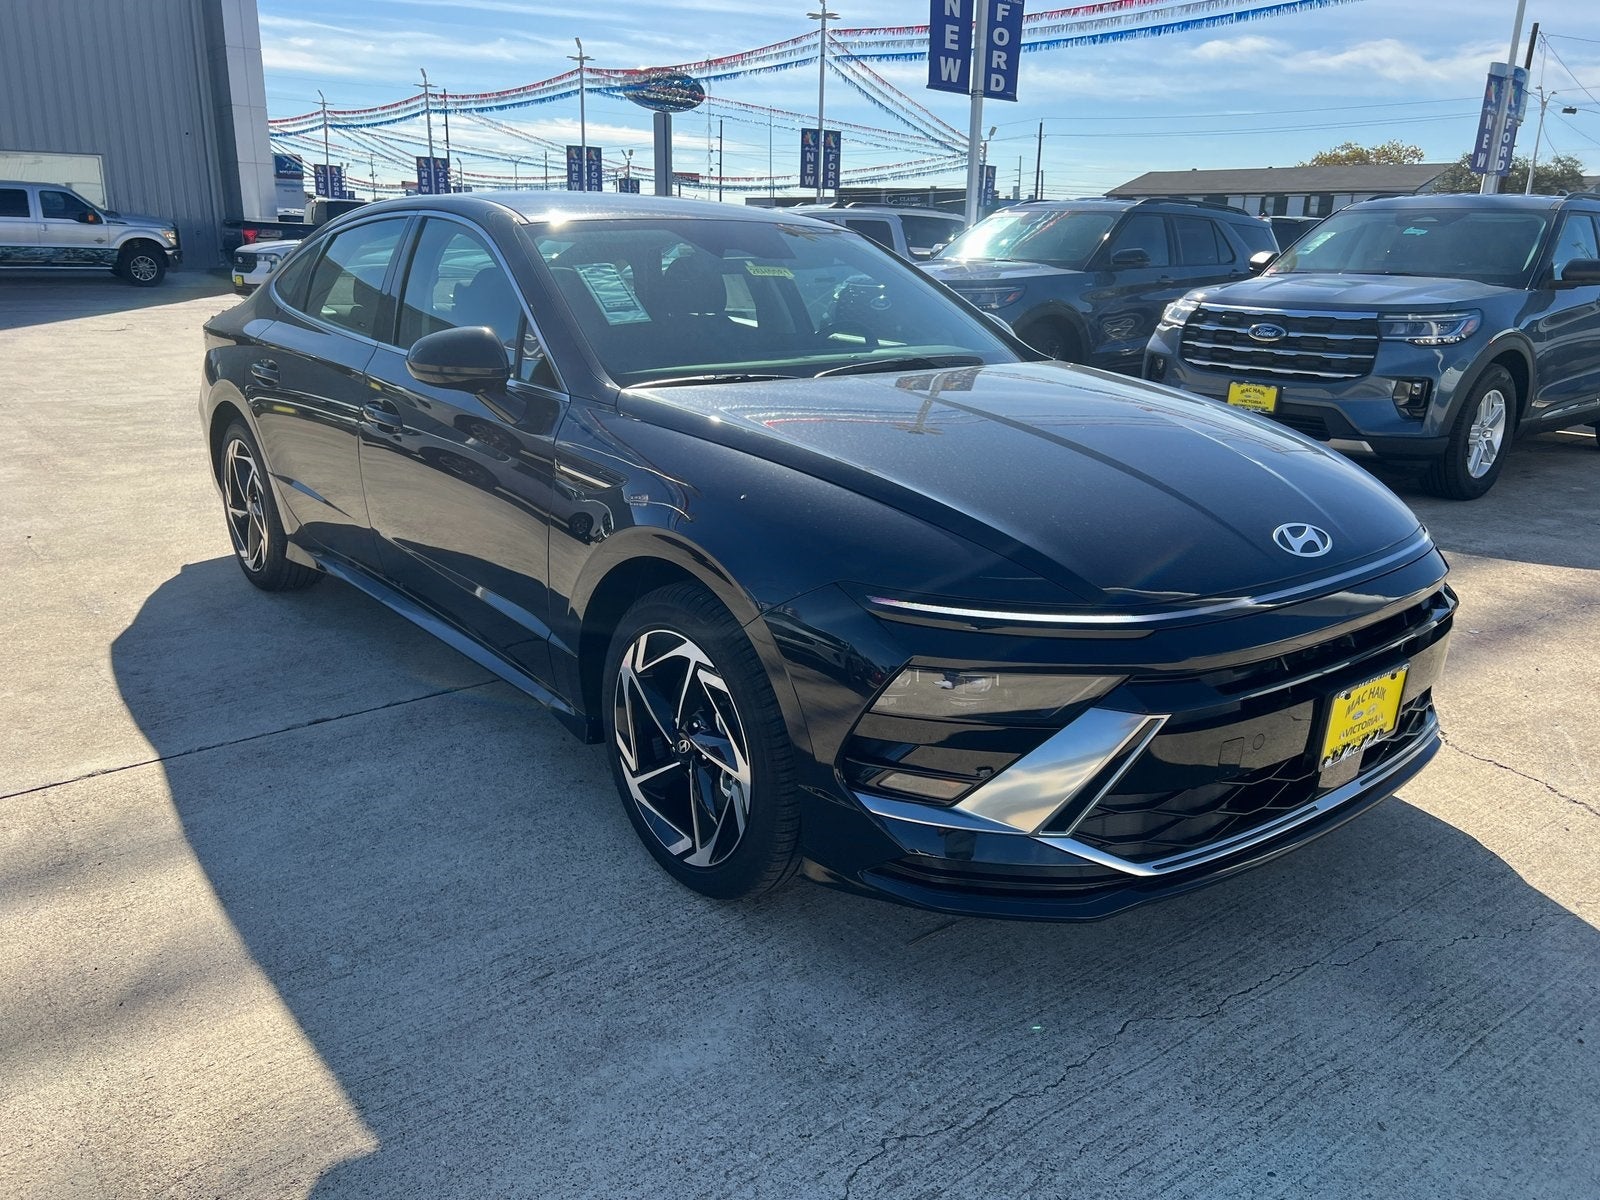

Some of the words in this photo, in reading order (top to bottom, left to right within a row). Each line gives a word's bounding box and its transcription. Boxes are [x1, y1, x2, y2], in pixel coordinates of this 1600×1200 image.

[940, 0, 961, 83] NEW
[990, 3, 1010, 92] FORD
[1476, 115, 1494, 168] NEW
[1498, 118, 1513, 170] FORD
[421, 171, 430, 193] NEW
[571, 163, 580, 190] NEW
[591, 165, 599, 191] FORD
[804, 152, 815, 186] NEW
[827, 154, 837, 187] FORD
[1255, 326, 1278, 337] Ford
[1345, 690, 1367, 718] MAC
[1345, 715, 1378, 737] VICTORIA
